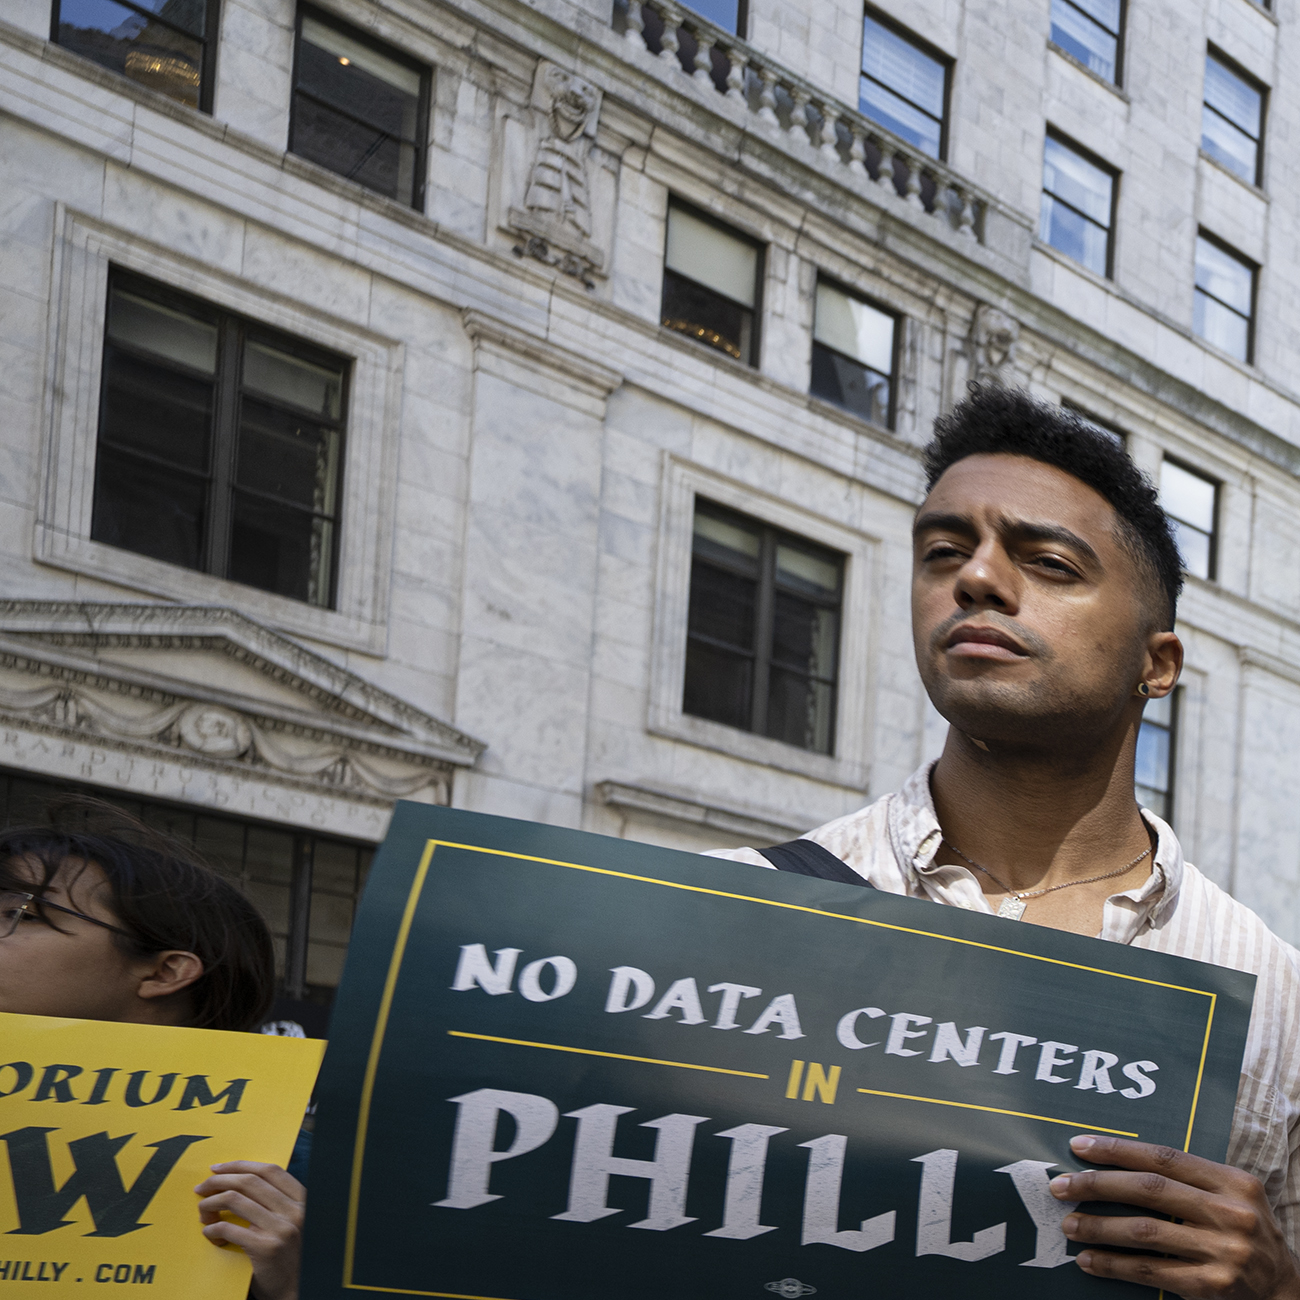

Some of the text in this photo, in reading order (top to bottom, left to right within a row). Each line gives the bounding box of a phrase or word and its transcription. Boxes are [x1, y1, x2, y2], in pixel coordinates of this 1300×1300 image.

[451, 942, 1161, 1100] NO DATA CENTERS
[786, 1059, 842, 1105] IN
[431, 1087, 1096, 1269] PHILLY
